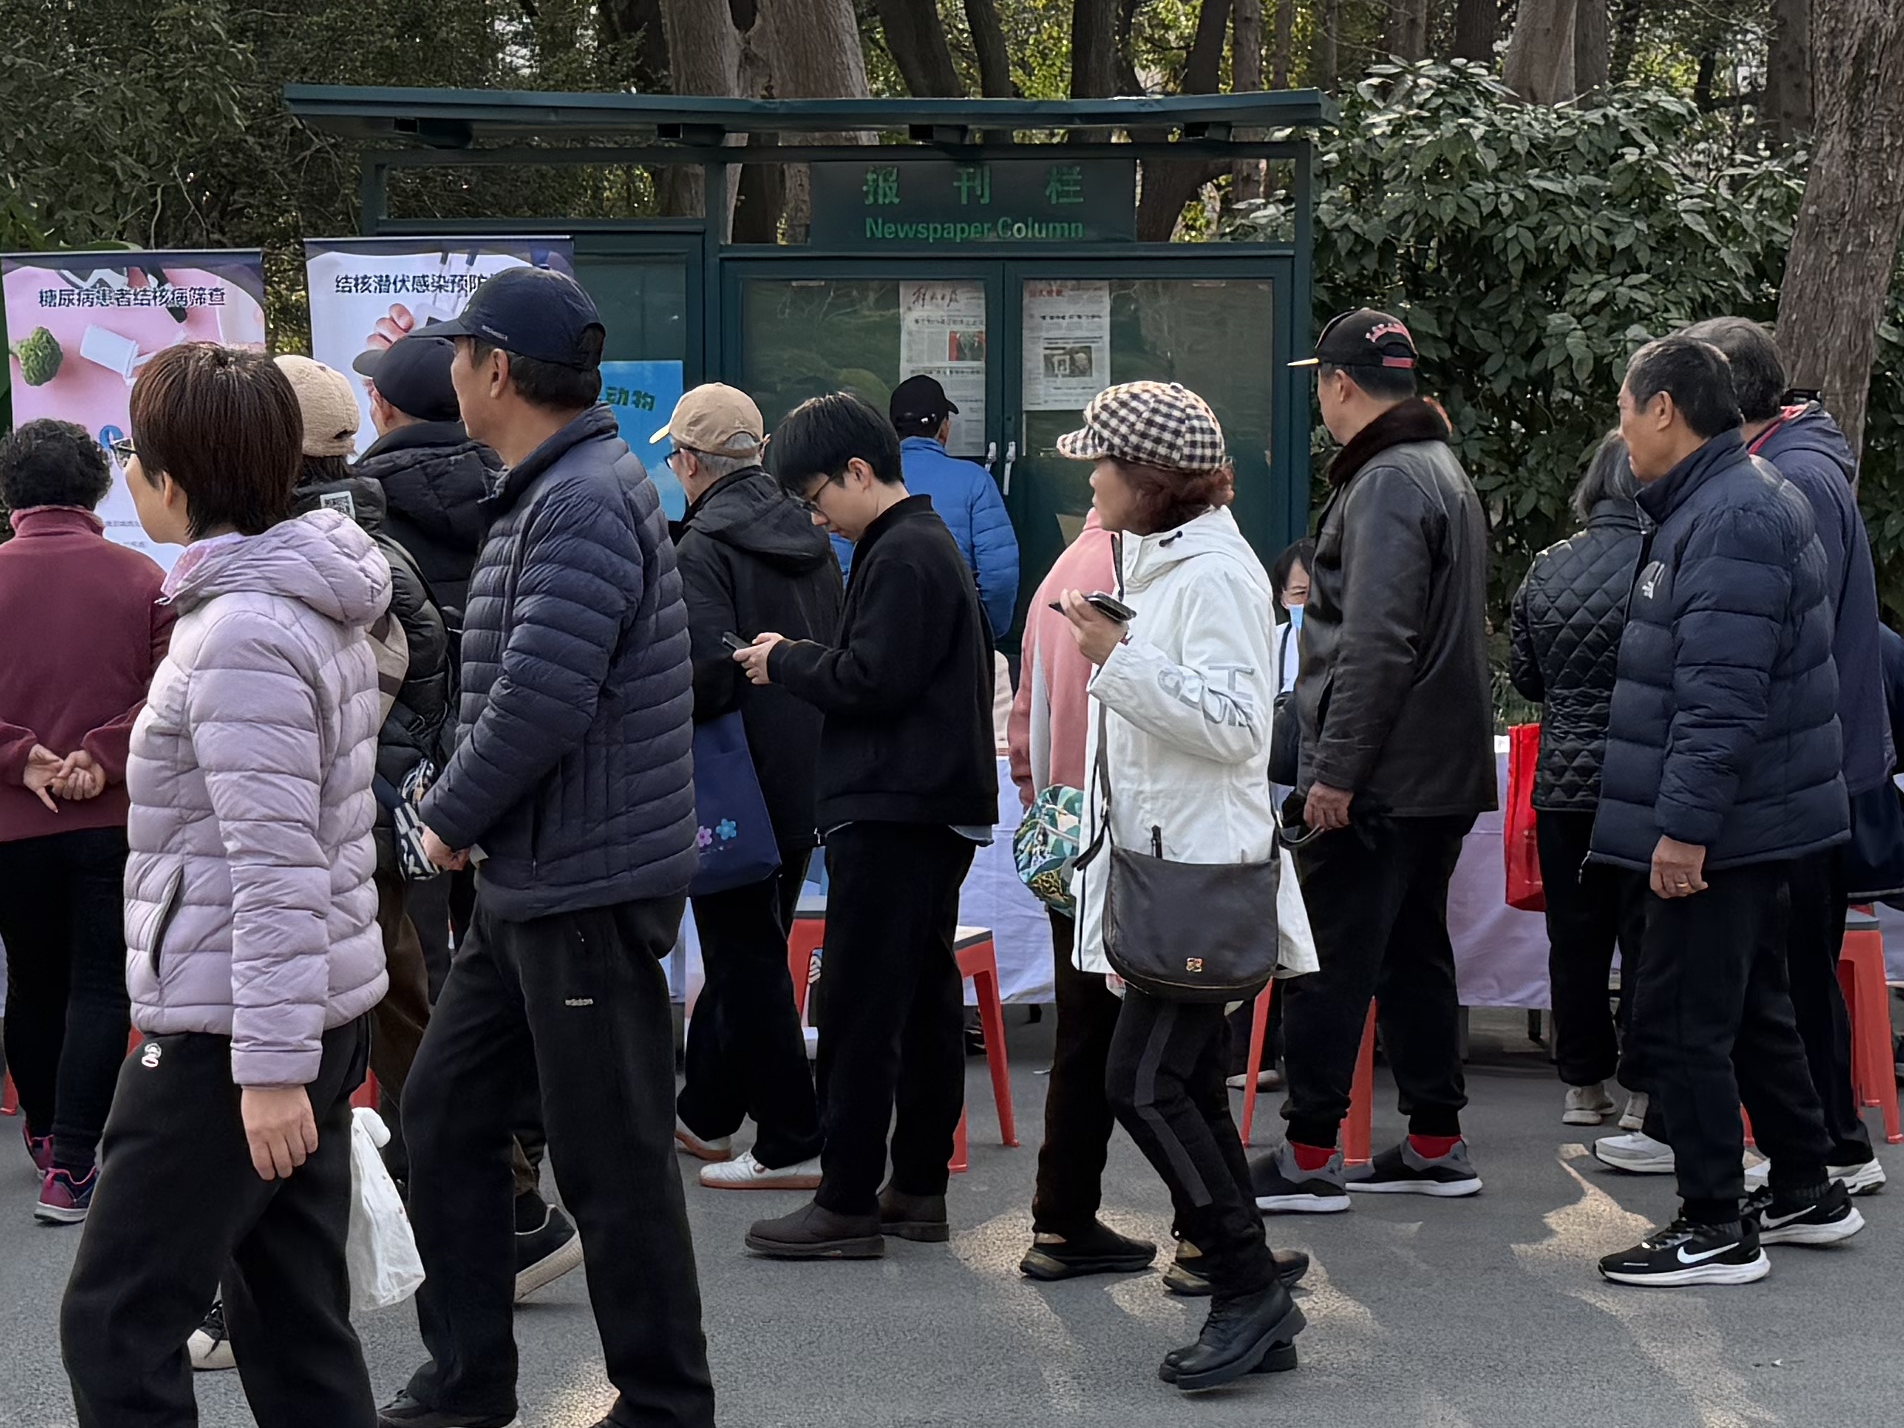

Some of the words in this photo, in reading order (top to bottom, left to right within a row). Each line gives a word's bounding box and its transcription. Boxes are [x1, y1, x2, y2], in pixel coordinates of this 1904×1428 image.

[862, 165, 1084, 205] 报刊栏
[865, 217, 992, 243] Newspaper
[997, 216, 1086, 239] Column
[335, 273, 495, 295] 结核潜伏感染预防
[38, 286, 226, 308] 糖尿病患者结核病筛查
[598, 386, 655, 411] 动物
